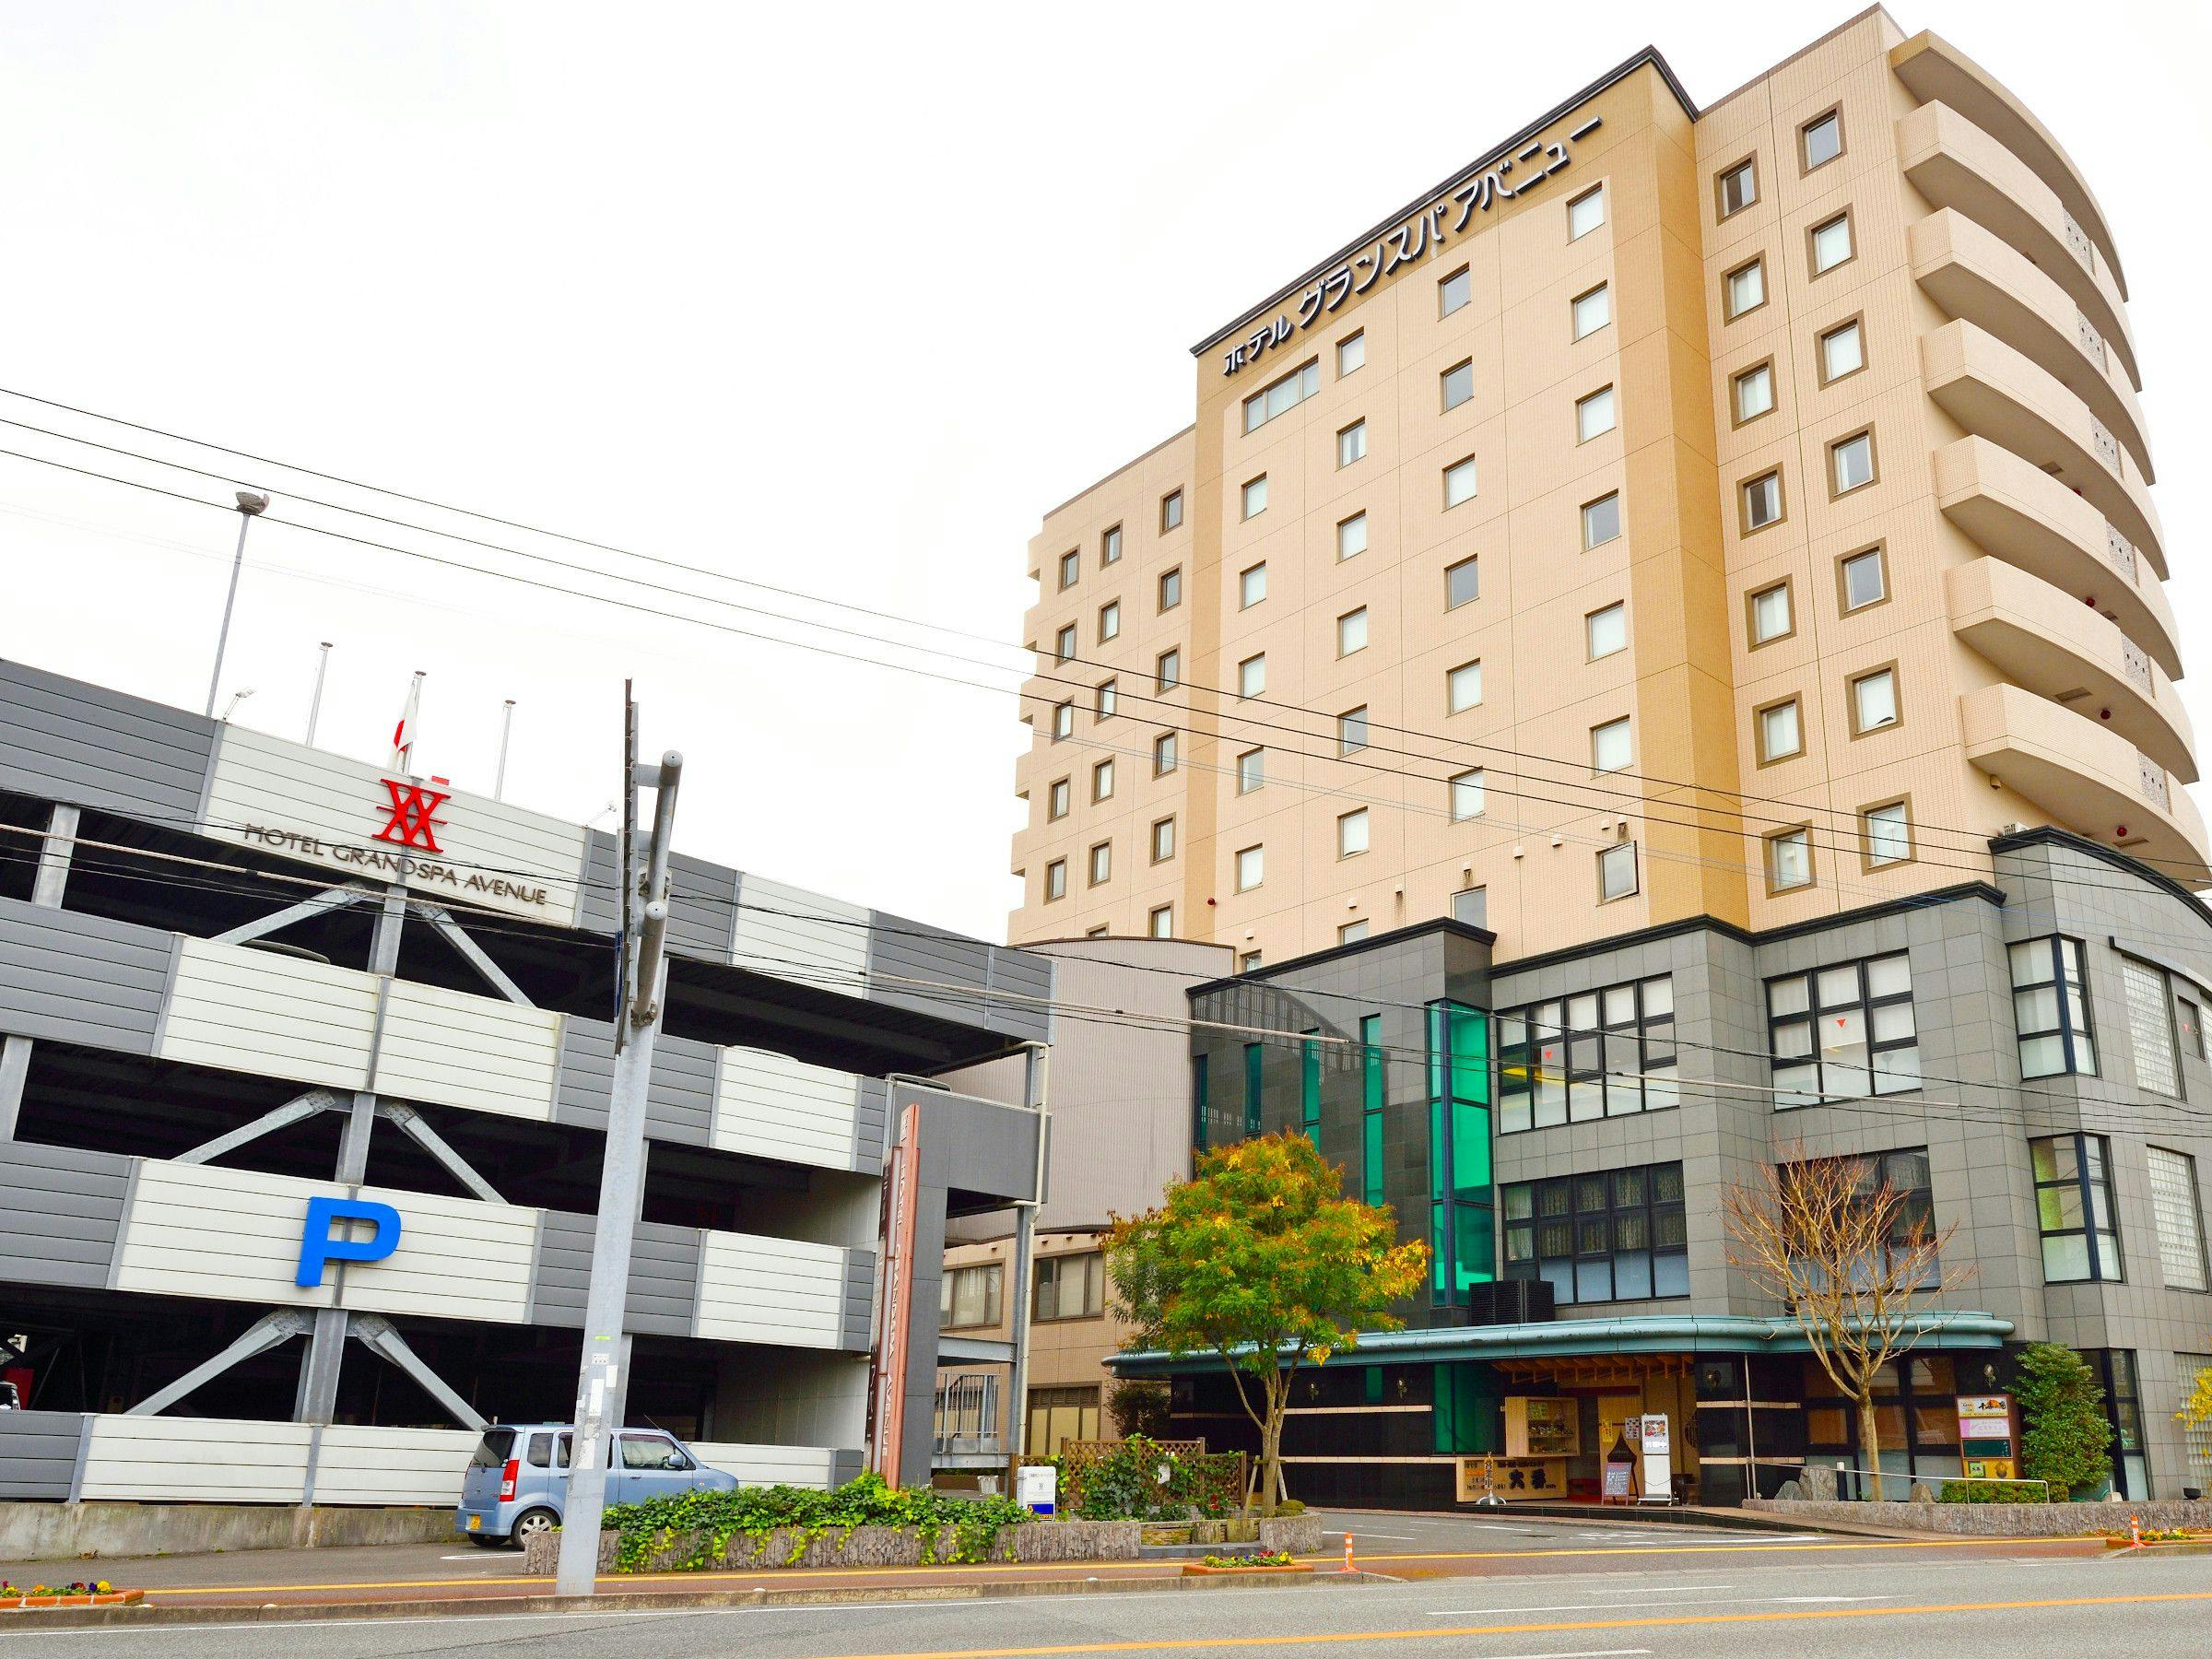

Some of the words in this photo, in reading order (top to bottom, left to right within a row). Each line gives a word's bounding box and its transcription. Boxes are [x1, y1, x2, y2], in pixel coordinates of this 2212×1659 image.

[244, 823, 324, 856] HOTEL
[332, 845, 458, 887] GRANDSPA
[464, 874, 547, 906] AVENUE
[295, 1196, 402, 1288] P
